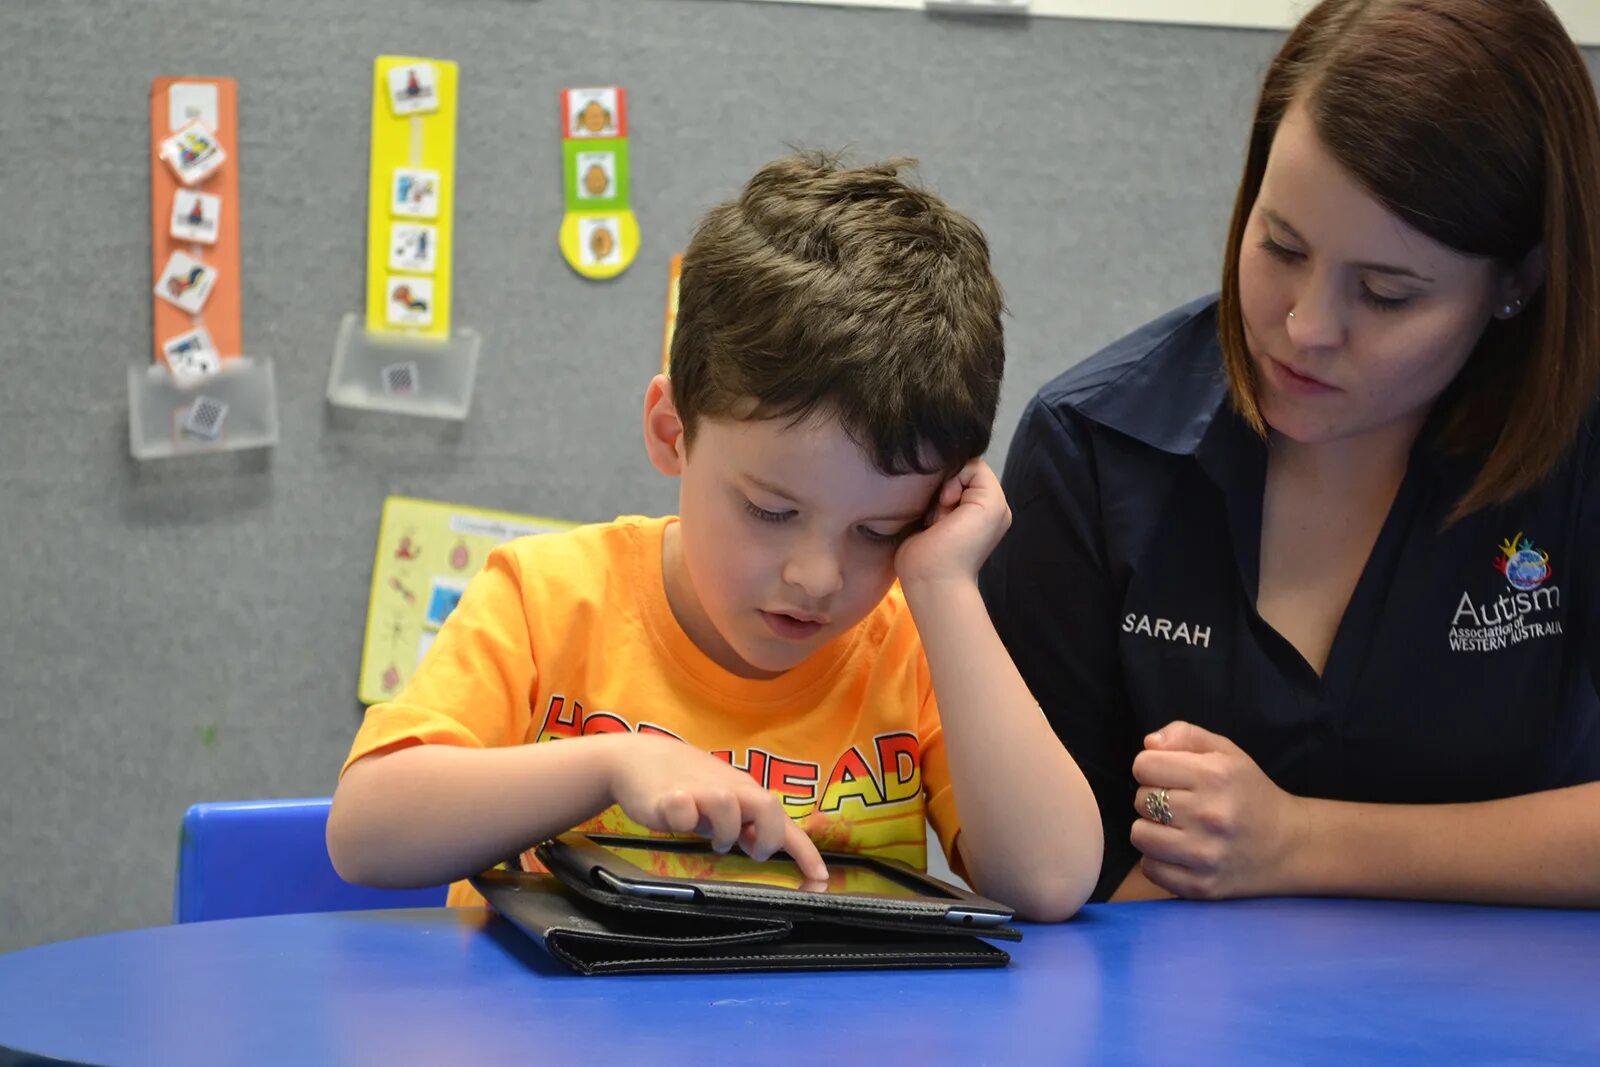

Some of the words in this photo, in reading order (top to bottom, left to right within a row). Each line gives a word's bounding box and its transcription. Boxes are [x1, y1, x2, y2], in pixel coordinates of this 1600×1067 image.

[1452, 585, 1560, 626] Autism
[1122, 612, 1211, 648] SARAH
[1449, 623, 1513, 639] Association
[1514, 614, 1525, 629] of
[1449, 634, 1507, 652] WESTERN
